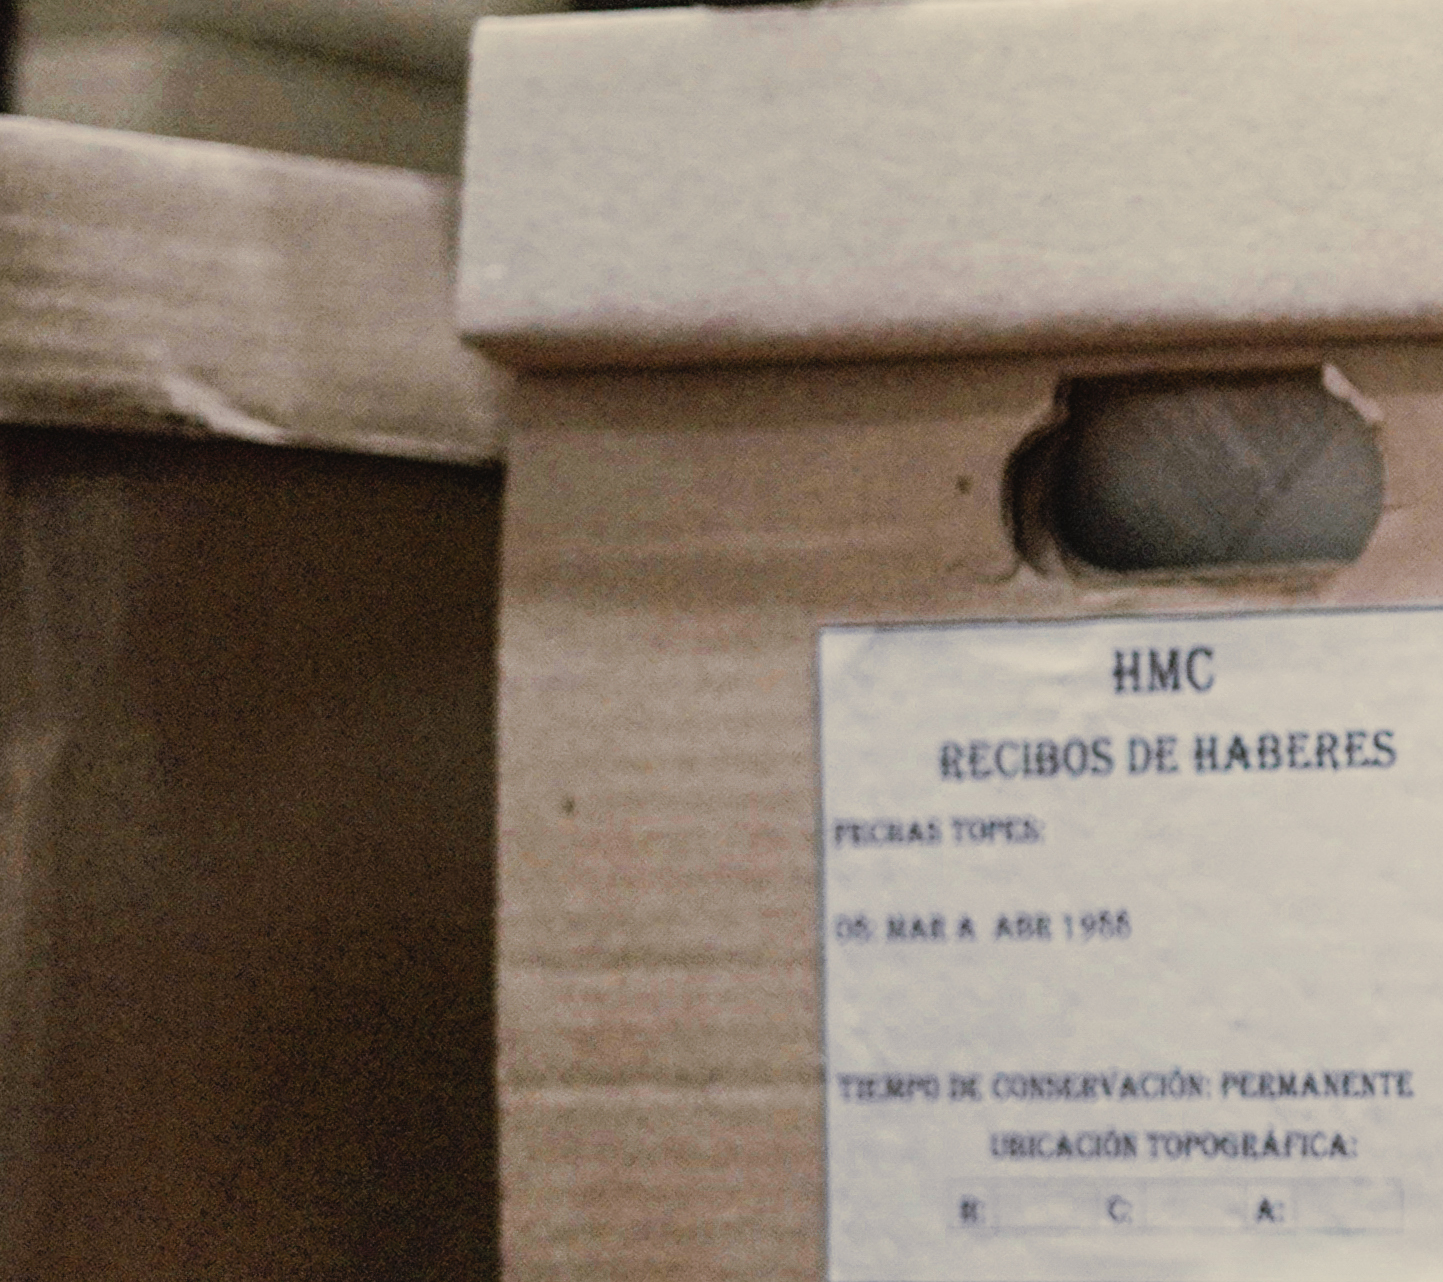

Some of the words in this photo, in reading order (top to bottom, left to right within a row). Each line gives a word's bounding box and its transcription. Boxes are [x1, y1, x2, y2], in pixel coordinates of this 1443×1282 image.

[1112, 646, 1216, 694] HMC
[939, 737, 1115, 780] RECIBOS
[1127, 735, 1180, 774] DE
[1193, 730, 1398, 772] HABERES
[1221, 1070, 1414, 1099] PERMANENTE
[990, 1128, 1137, 1160] UBICACIÓN
